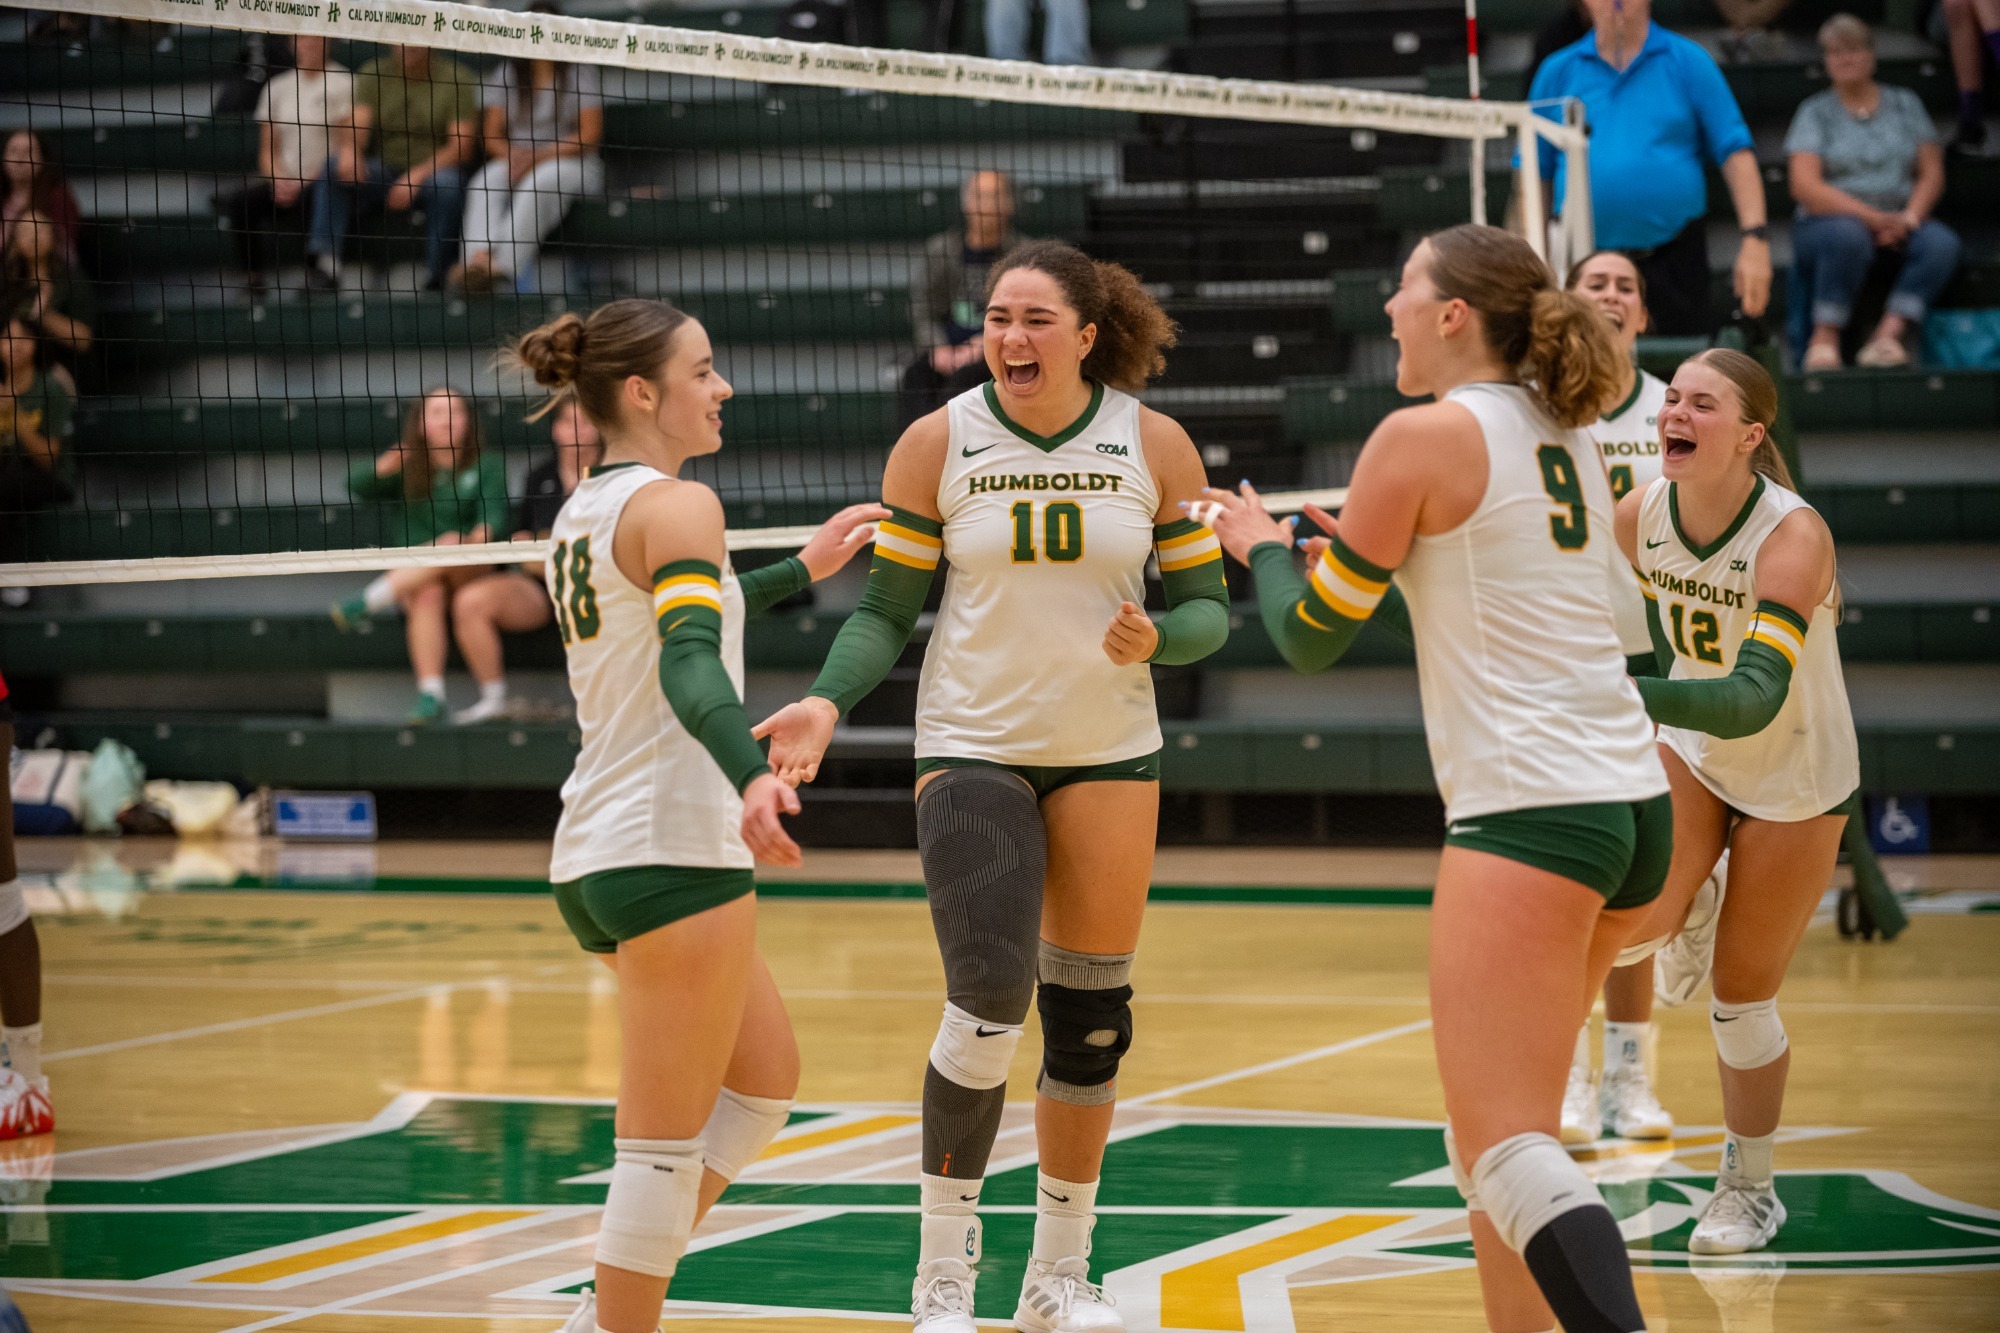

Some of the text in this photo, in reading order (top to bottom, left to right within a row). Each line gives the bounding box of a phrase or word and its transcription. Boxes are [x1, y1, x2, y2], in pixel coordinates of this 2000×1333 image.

[239, 0, 320, 17] CAL POLY HUMBOLDT
[348, 8, 427, 27] CAL POLY HUMBOLDT
[452, 19, 526, 39] CAL POLY HUMBOLDT
[565, 33, 582, 46] POLY
[1095, 443, 1128, 457] CCAA
[1603, 441, 1660, 456] BOLD
[969, 473, 1123, 495] HUMBOLDT
[1535, 443, 1589, 552] 9
[1009, 500, 1085, 564] 10
[553, 534, 602, 646] 18
[1669, 601, 1724, 666] 12
